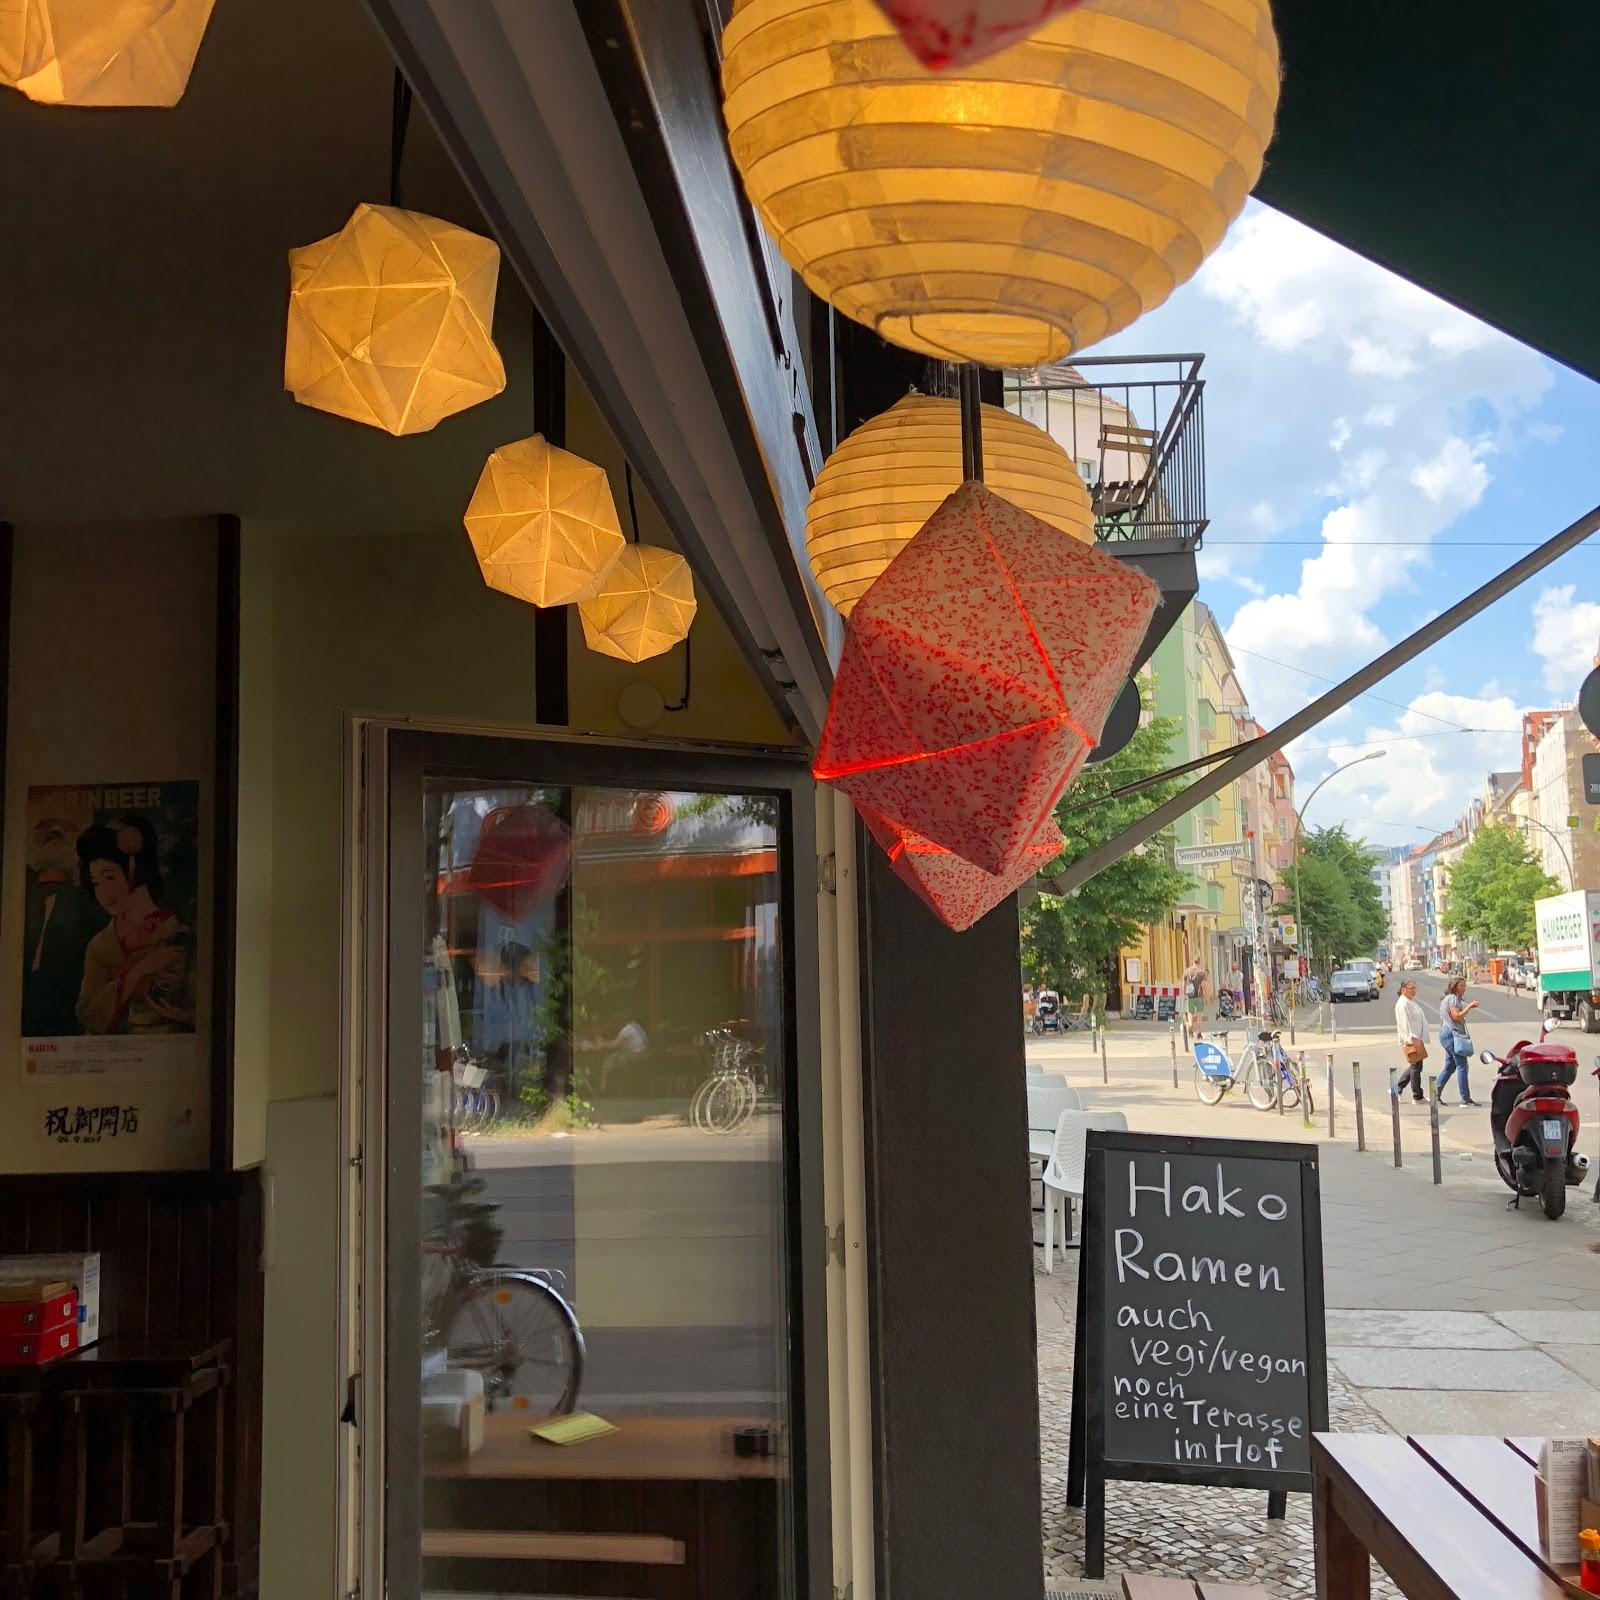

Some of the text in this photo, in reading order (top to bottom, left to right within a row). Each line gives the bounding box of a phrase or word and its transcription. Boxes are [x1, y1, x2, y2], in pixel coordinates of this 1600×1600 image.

[104, 787, 161, 809] BEER
[1541, 912, 1583, 943] HAMBERGER
[28, 1043, 57, 1053] KIRIN
[1128, 1160, 1288, 1221] Hako
[1114, 1227, 1286, 1292] Ramen
[1117, 1298, 1214, 1332] auch
[1113, 1375, 1185, 1399] noch
[1115, 1396, 1302, 1439] eine Terasse
[1174, 1427, 1284, 1469] im Hof
